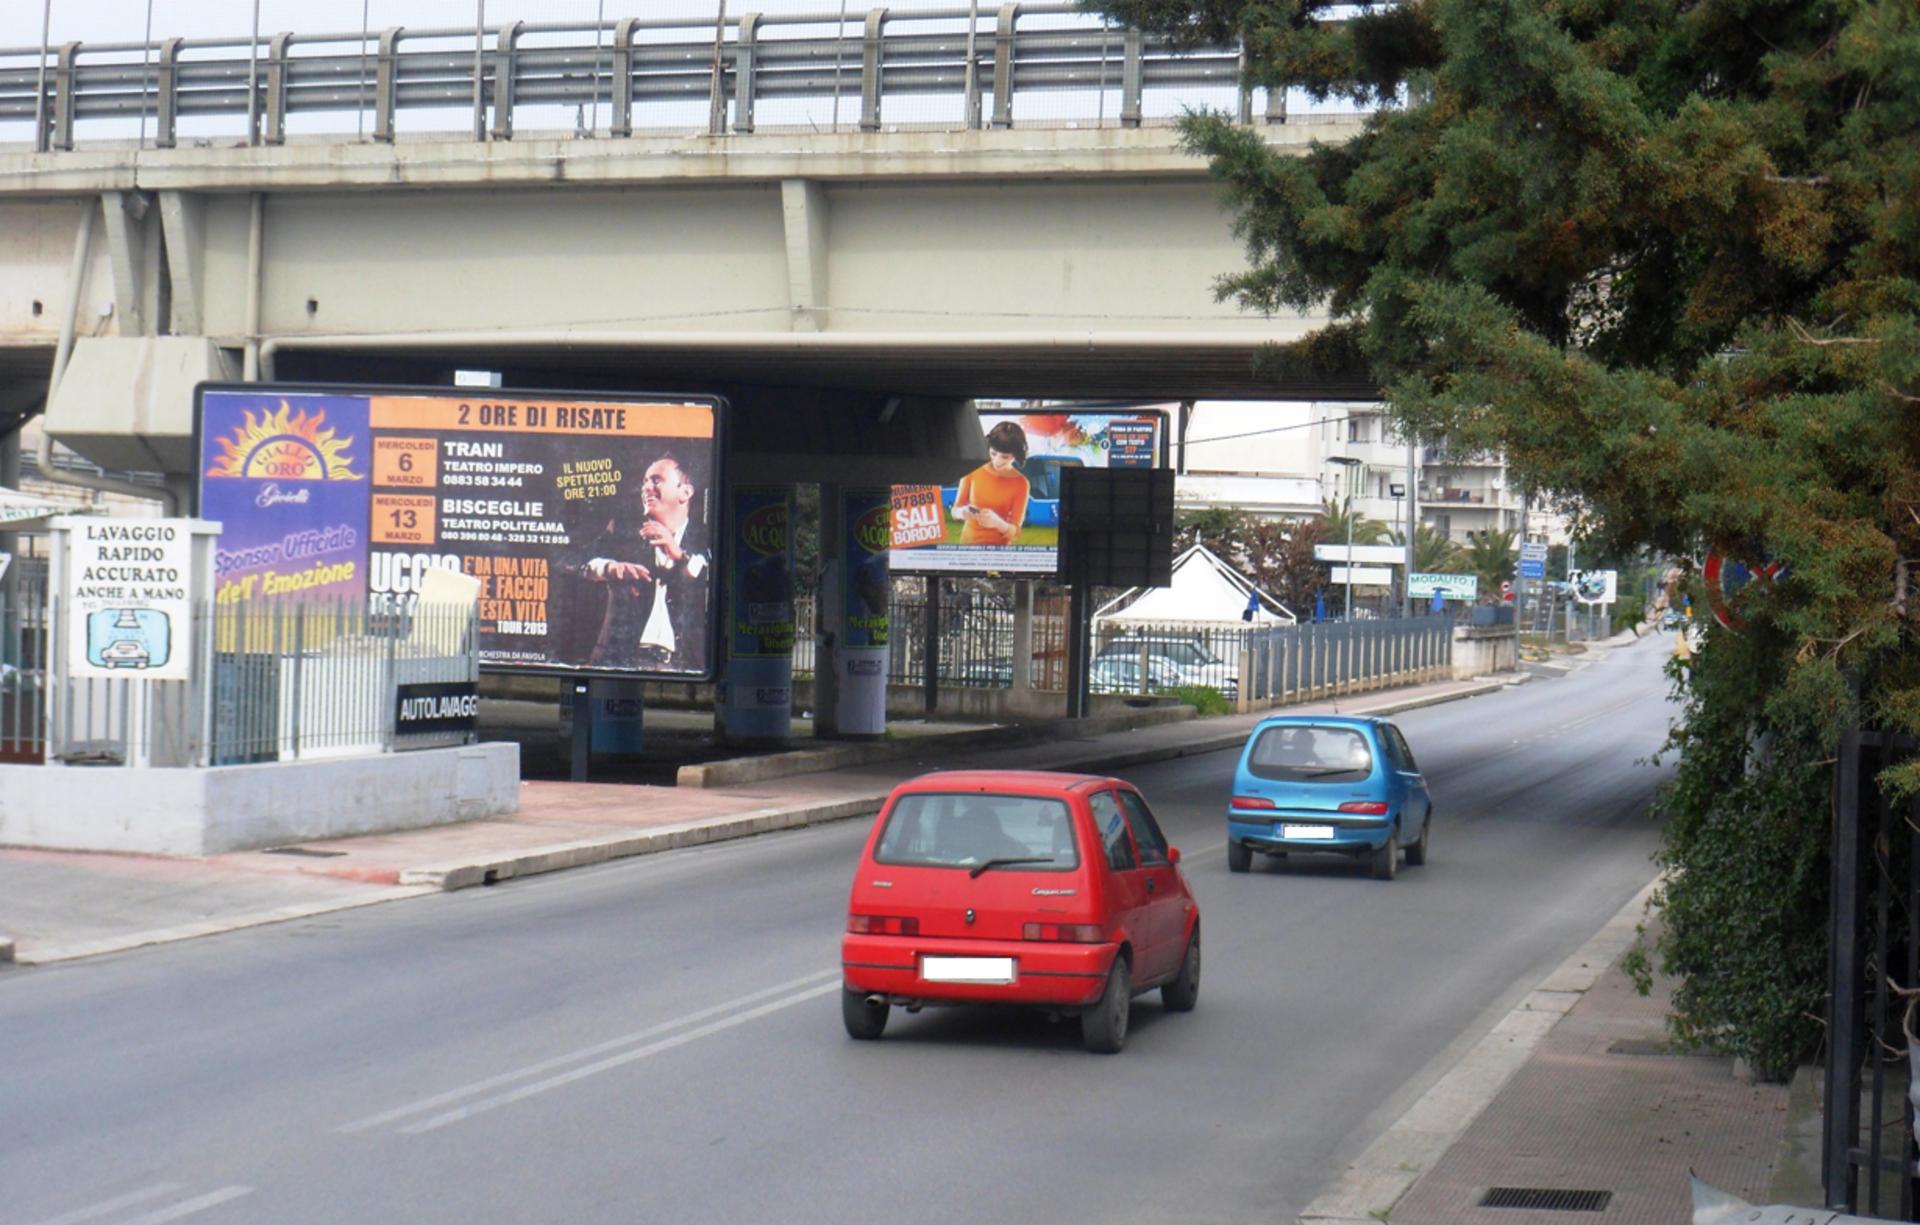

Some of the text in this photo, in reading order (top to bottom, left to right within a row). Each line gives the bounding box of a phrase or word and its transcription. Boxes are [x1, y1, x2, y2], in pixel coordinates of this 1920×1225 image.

[458, 404, 627, 430] 2 ORE DI RISATE
[255, 442, 316, 468] GIALLO
[444, 442, 504, 458] TRANI
[266, 462, 305, 476] ORO
[399, 452, 413, 472] 6
[443, 462, 544, 474] TEATRO IMPERO
[564, 458, 612, 474] IL NUOVO
[387, 475, 424, 484] MARZO
[556, 471, 622, 488] SPETTACOLO
[564, 484, 616, 500] ORE 21:00
[442, 500, 544, 516] BISCEGLIE
[390, 508, 417, 528] 13
[442, 518, 564, 532] TEATRO POLITEAMA
[87, 526, 176, 541] LAVAGGIO
[385, 532, 422, 540] MARZO
[894, 524, 942, 545] BORDO!
[98, 546, 164, 562] RAPIDO
[215, 525, 356, 576] Sponsor Ufficiale
[83, 568, 178, 582] ACCURATO
[494, 557, 520, 576] UNA
[522, 558, 548, 578] VITA
[262, 561, 356, 595] Emozione
[76, 586, 184, 600] ANCHE A MANO
[496, 577, 548, 602] FACCIO
[480, 600, 548, 622] ESTA VITA
[497, 620, 522, 634] TOUR
[524, 622, 548, 636] 2013
[478, 650, 510, 660] RCHESTRA
